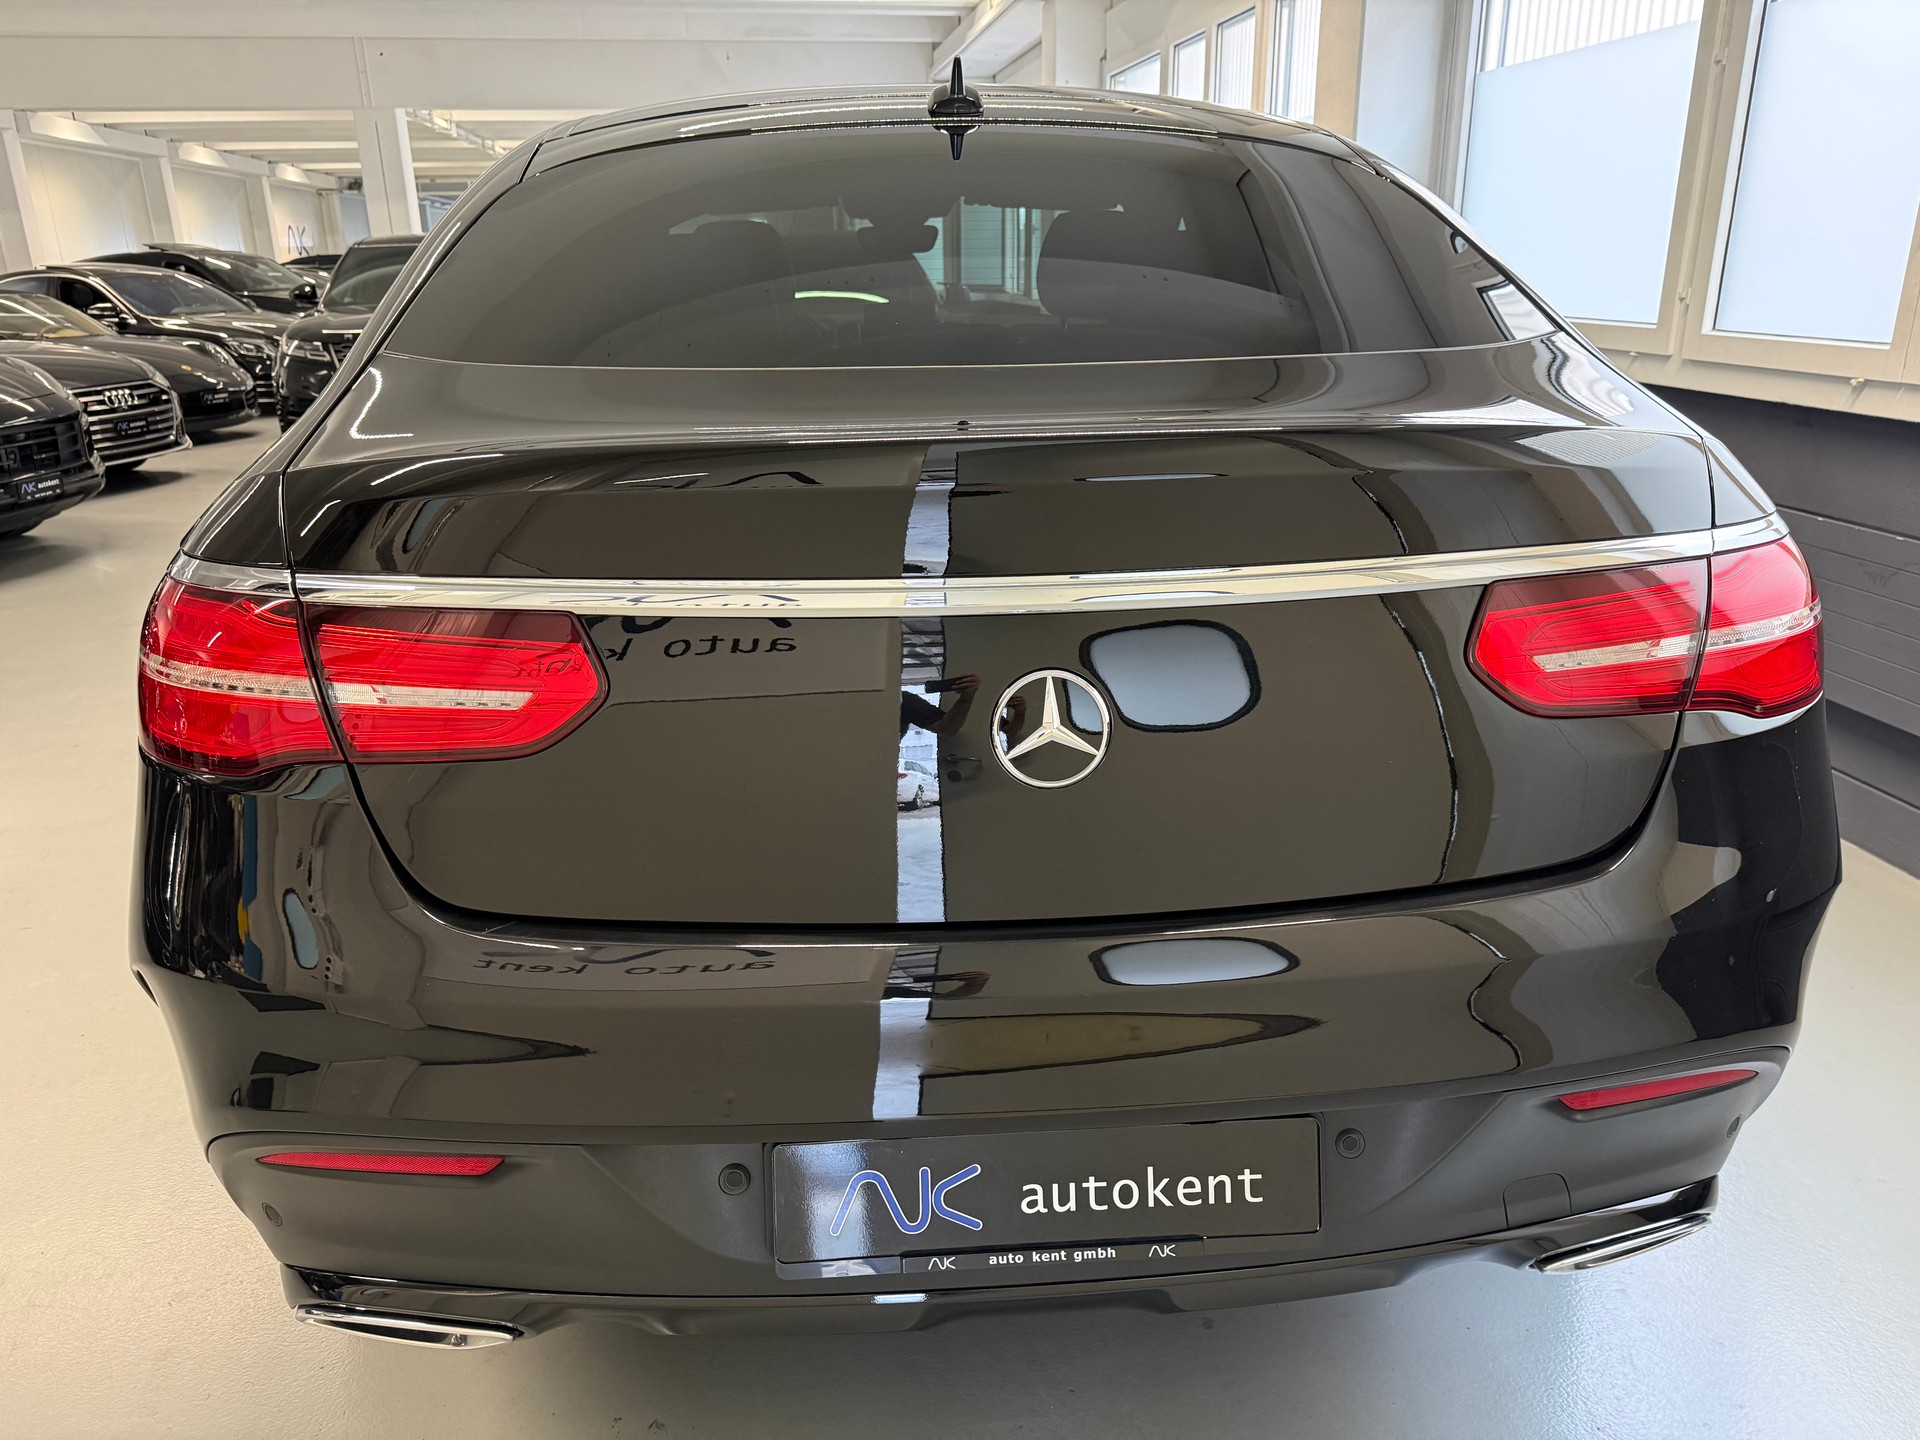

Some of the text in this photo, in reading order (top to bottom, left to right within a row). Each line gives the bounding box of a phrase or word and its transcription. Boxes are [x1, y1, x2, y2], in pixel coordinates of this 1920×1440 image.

[1019, 1166, 1265, 1214] autokent
[988, 1252, 1024, 1265] auto
[1032, 1249, 1067, 1263] kent
[1073, 1247, 1116, 1263] gmbh
